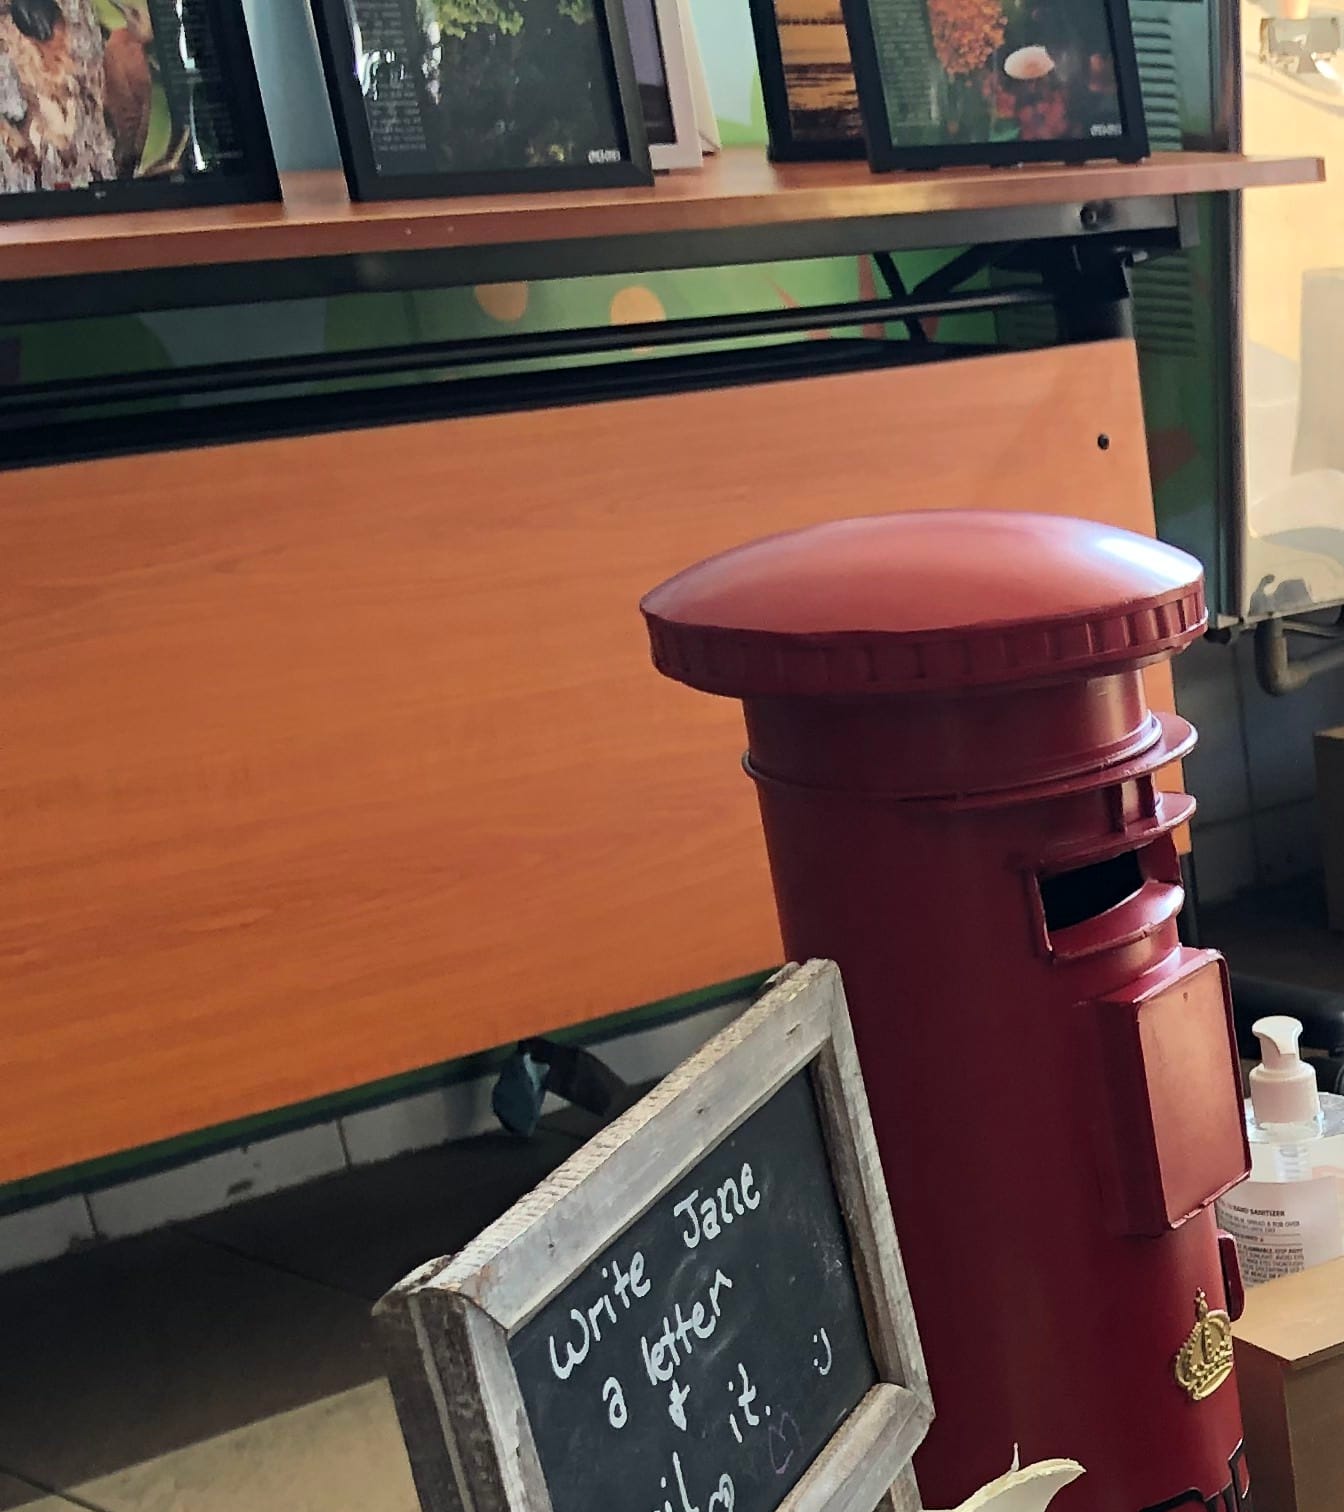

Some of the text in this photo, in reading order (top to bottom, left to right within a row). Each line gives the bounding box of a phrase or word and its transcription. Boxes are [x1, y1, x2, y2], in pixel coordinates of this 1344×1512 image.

[549, 1162, 761, 1380] Write Jane
[1250, 1208, 1286, 1217] SANITIZER
[602, 1269, 733, 1429] a letter
